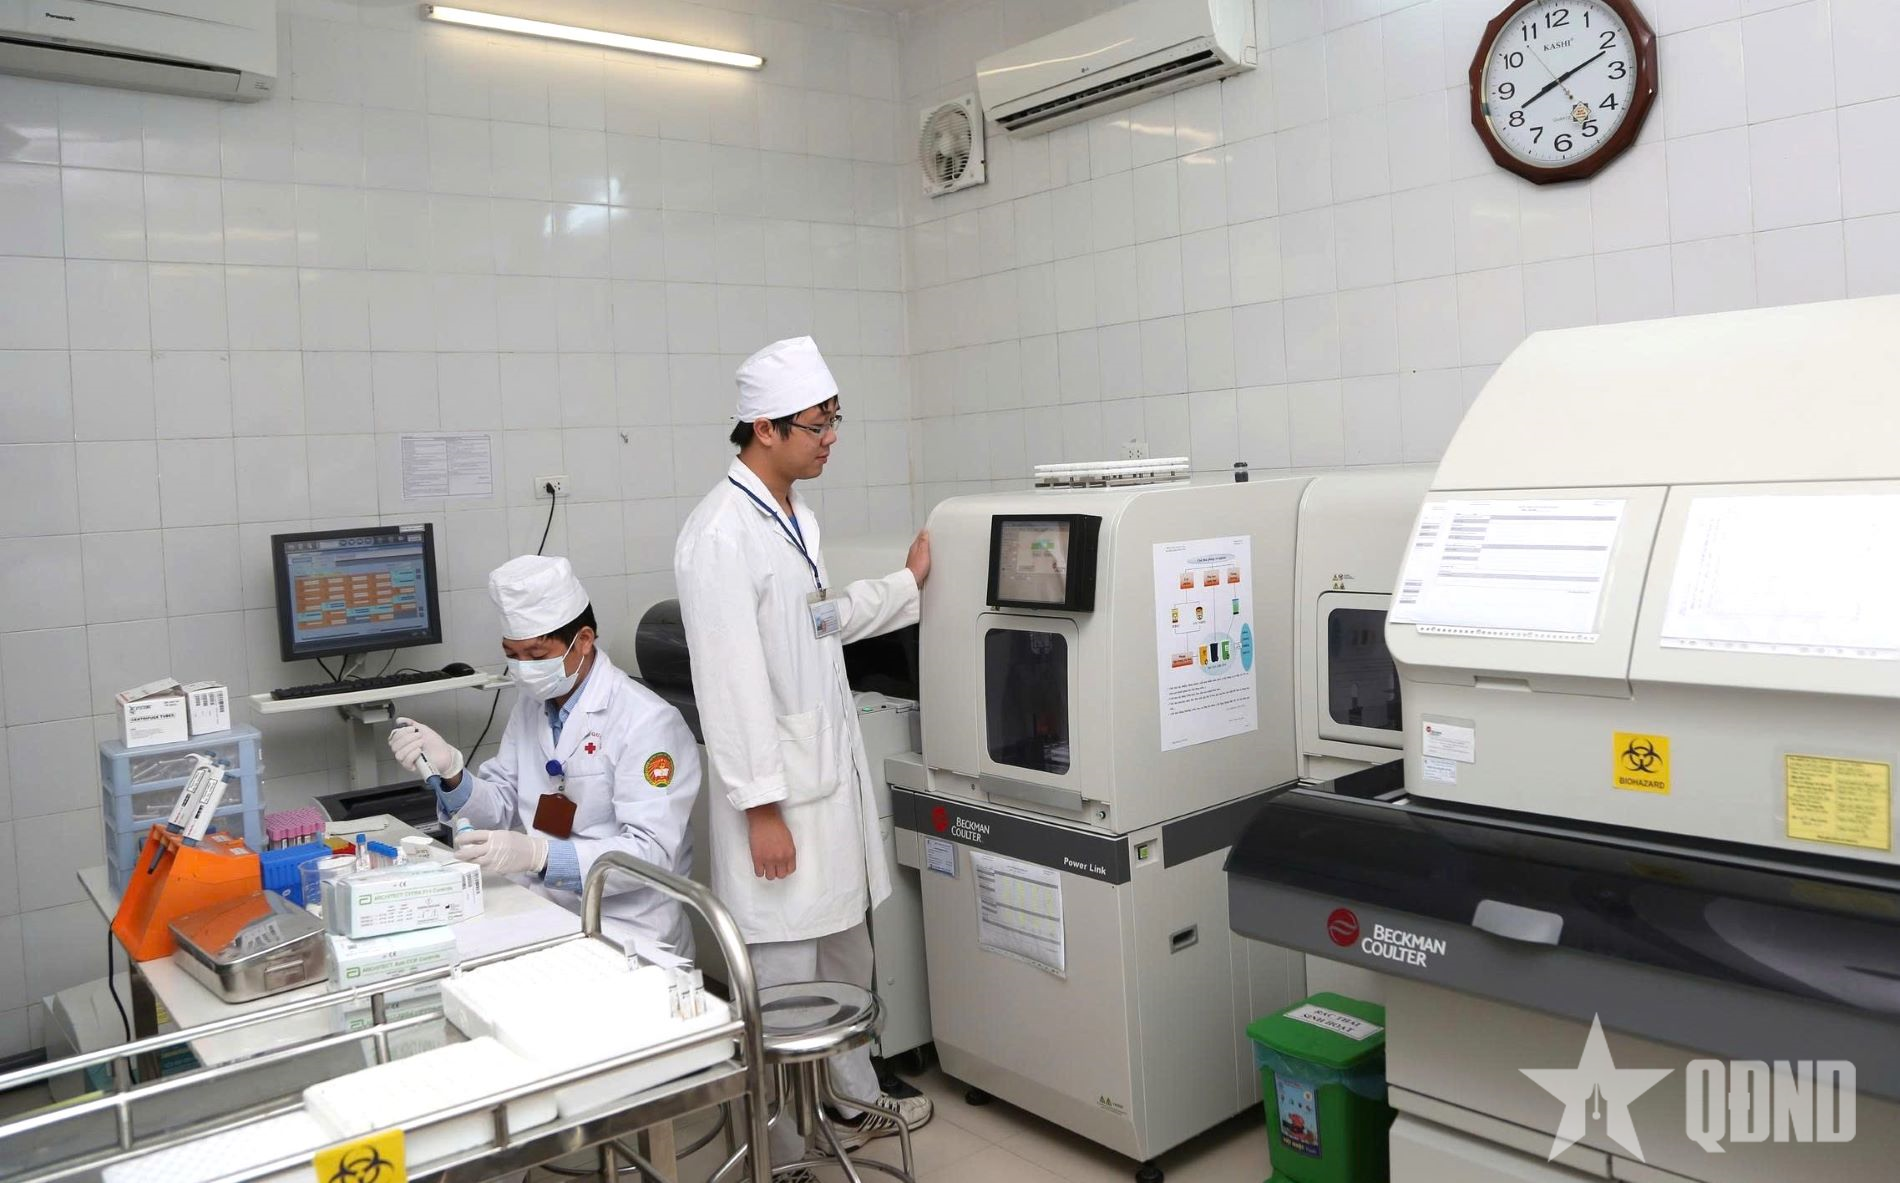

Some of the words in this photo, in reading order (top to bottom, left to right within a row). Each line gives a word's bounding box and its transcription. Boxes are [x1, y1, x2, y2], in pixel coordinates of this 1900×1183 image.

[1544, 8, 1570, 29] 12
[1583, 11, 1589, 28] 1
[1521, 22, 1538, 42] 11
[1599, 30, 1617, 50] 2
[1543, 39, 1572, 52] KASHI
[1503, 51, 1524, 70] 10
[1607, 60, 1627, 80] 3
[1498, 82, 1516, 101] 9
[1598, 92, 1619, 111] 4
[1508, 110, 1526, 128] 8
[1581, 118, 1599, 138] 5
[1529, 126, 1544, 145] 7
[1553, 133, 1573, 152] 6
[1618, 776, 1665, 789] BIOHAZARD
[951, 825, 982, 843] COULTER
[956, 816, 990, 835] BECKMAN
[1063, 856, 1088, 871] Power
[1089, 863, 1107, 876] Link
[1373, 923, 1447, 956] BECKMAN
[1361, 937, 1428, 968] COULTER
